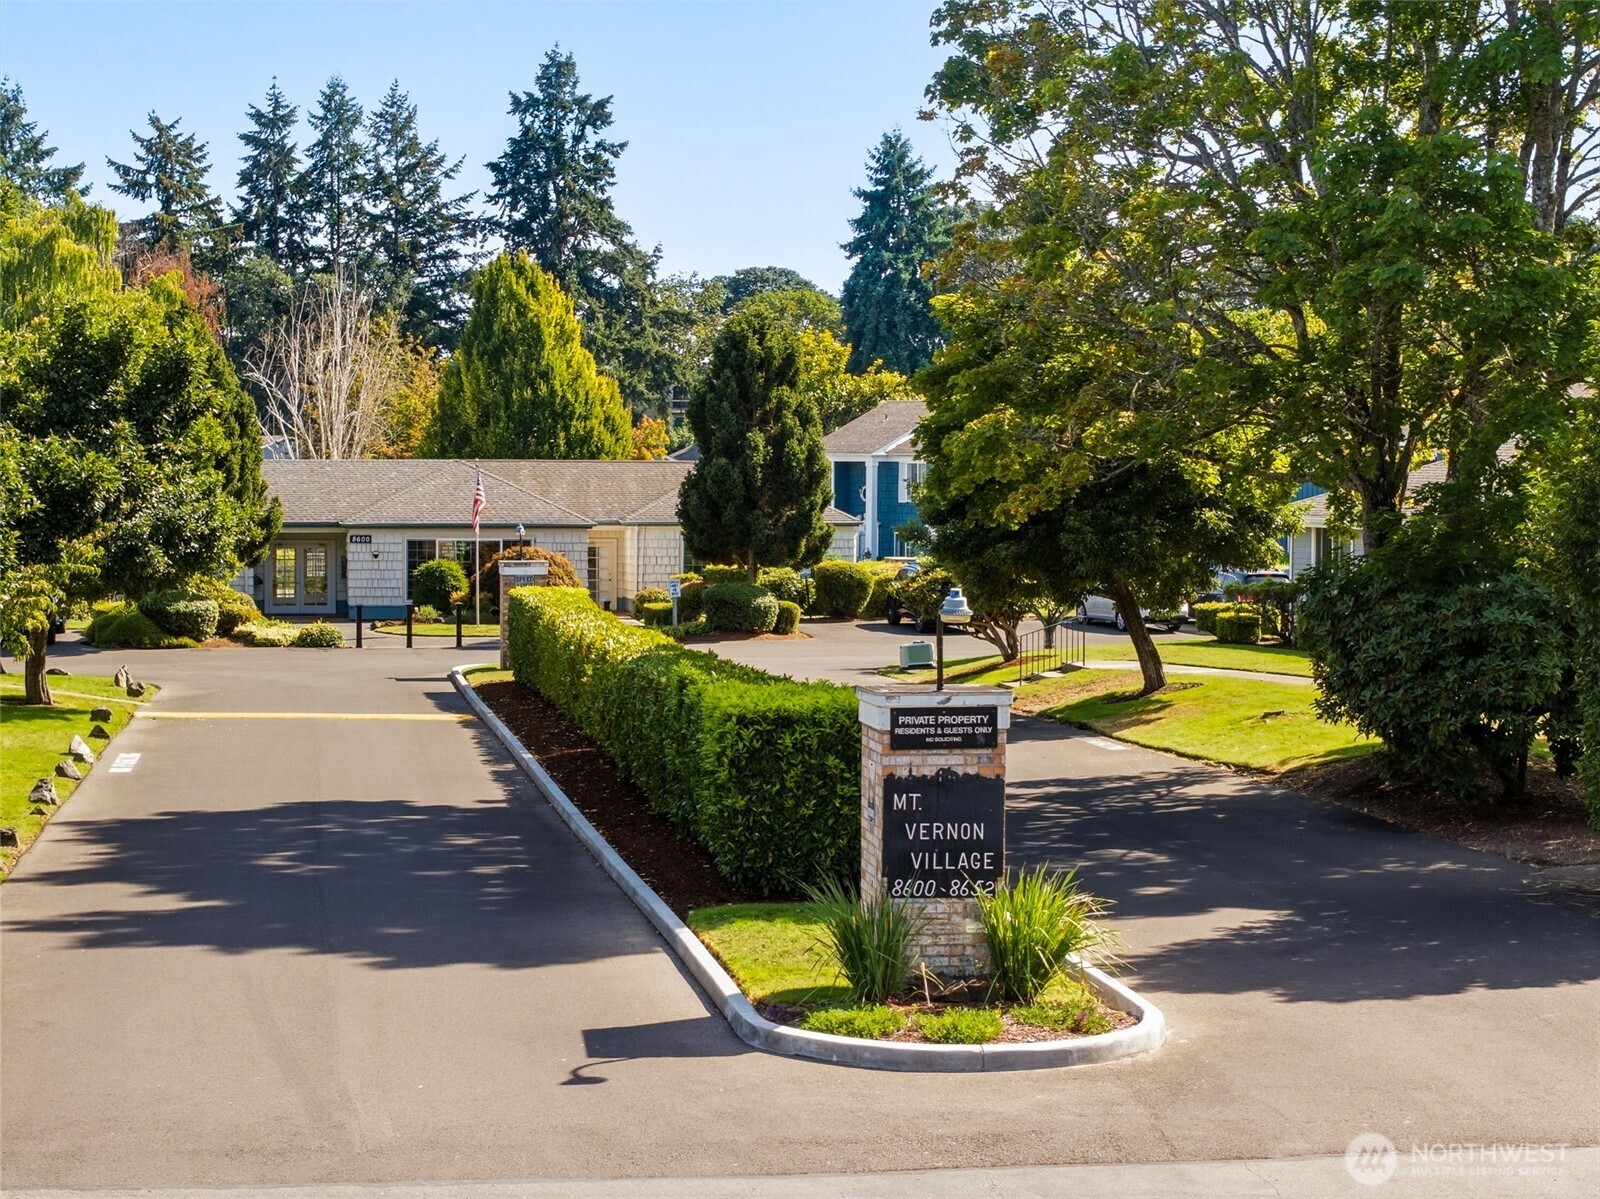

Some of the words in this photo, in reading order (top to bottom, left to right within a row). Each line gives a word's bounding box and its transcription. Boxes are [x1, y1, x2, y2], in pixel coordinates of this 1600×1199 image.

[898, 716, 936, 725] PRIVATE
[938, 715, 989, 724] PROPERTY
[893, 793, 922, 811] MT.
[905, 822, 985, 840] VERNON
[910, 852, 994, 870] VILLAGE
